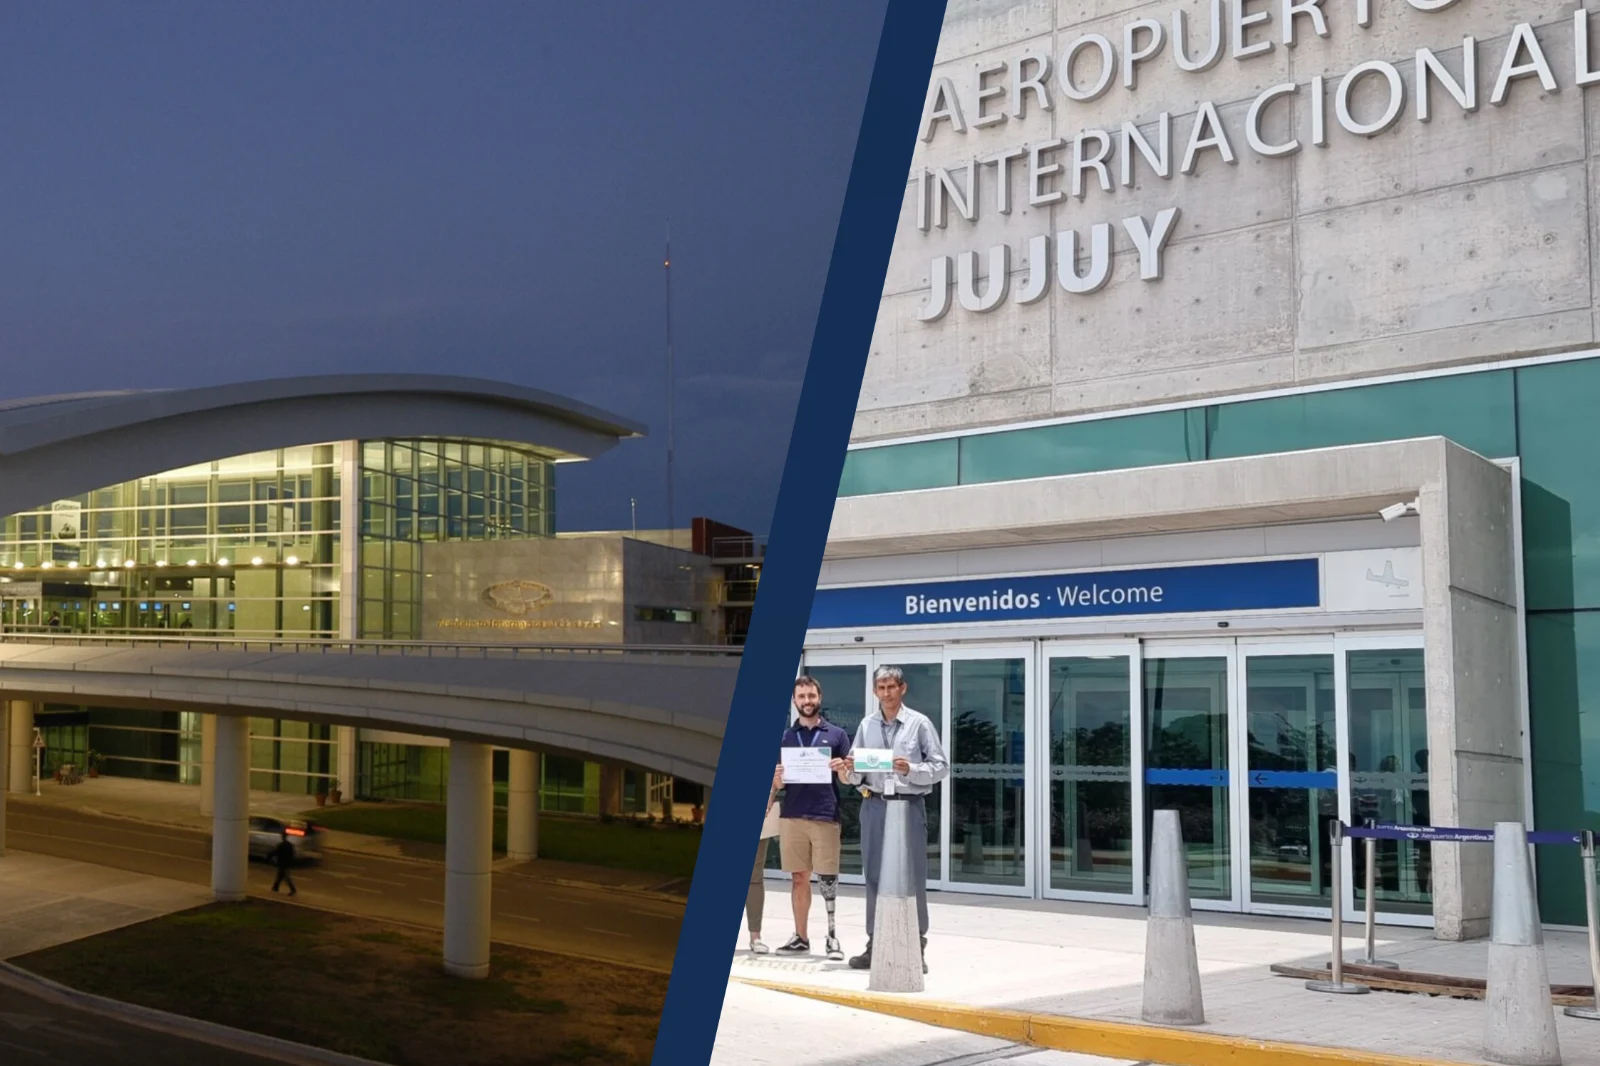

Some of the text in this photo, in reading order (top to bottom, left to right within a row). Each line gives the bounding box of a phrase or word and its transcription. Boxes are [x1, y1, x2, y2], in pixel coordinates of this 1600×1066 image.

[917, 8, 1600, 231] INTERNACIONAL
[920, 0, 1462, 143] AEROPUER
[917, 206, 1180, 321] JUJUY
[905, 584, 1163, 615] Bienvenidos Welcome
